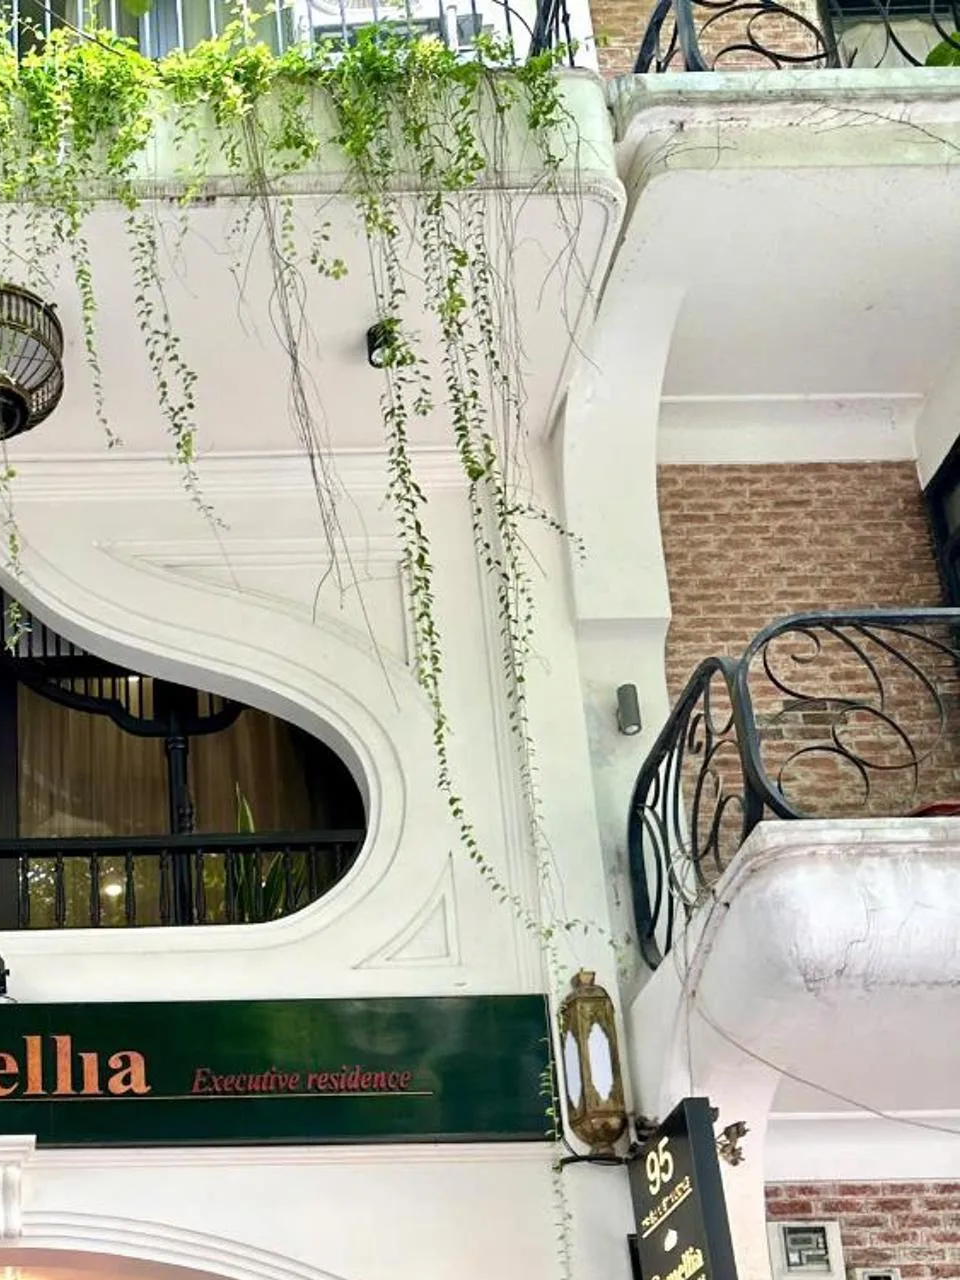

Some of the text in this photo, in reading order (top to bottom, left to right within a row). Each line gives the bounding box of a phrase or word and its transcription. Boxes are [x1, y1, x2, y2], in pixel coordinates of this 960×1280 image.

[191, 1064, 412, 1094] Executive residence
[646, 1136, 674, 1195] 95
